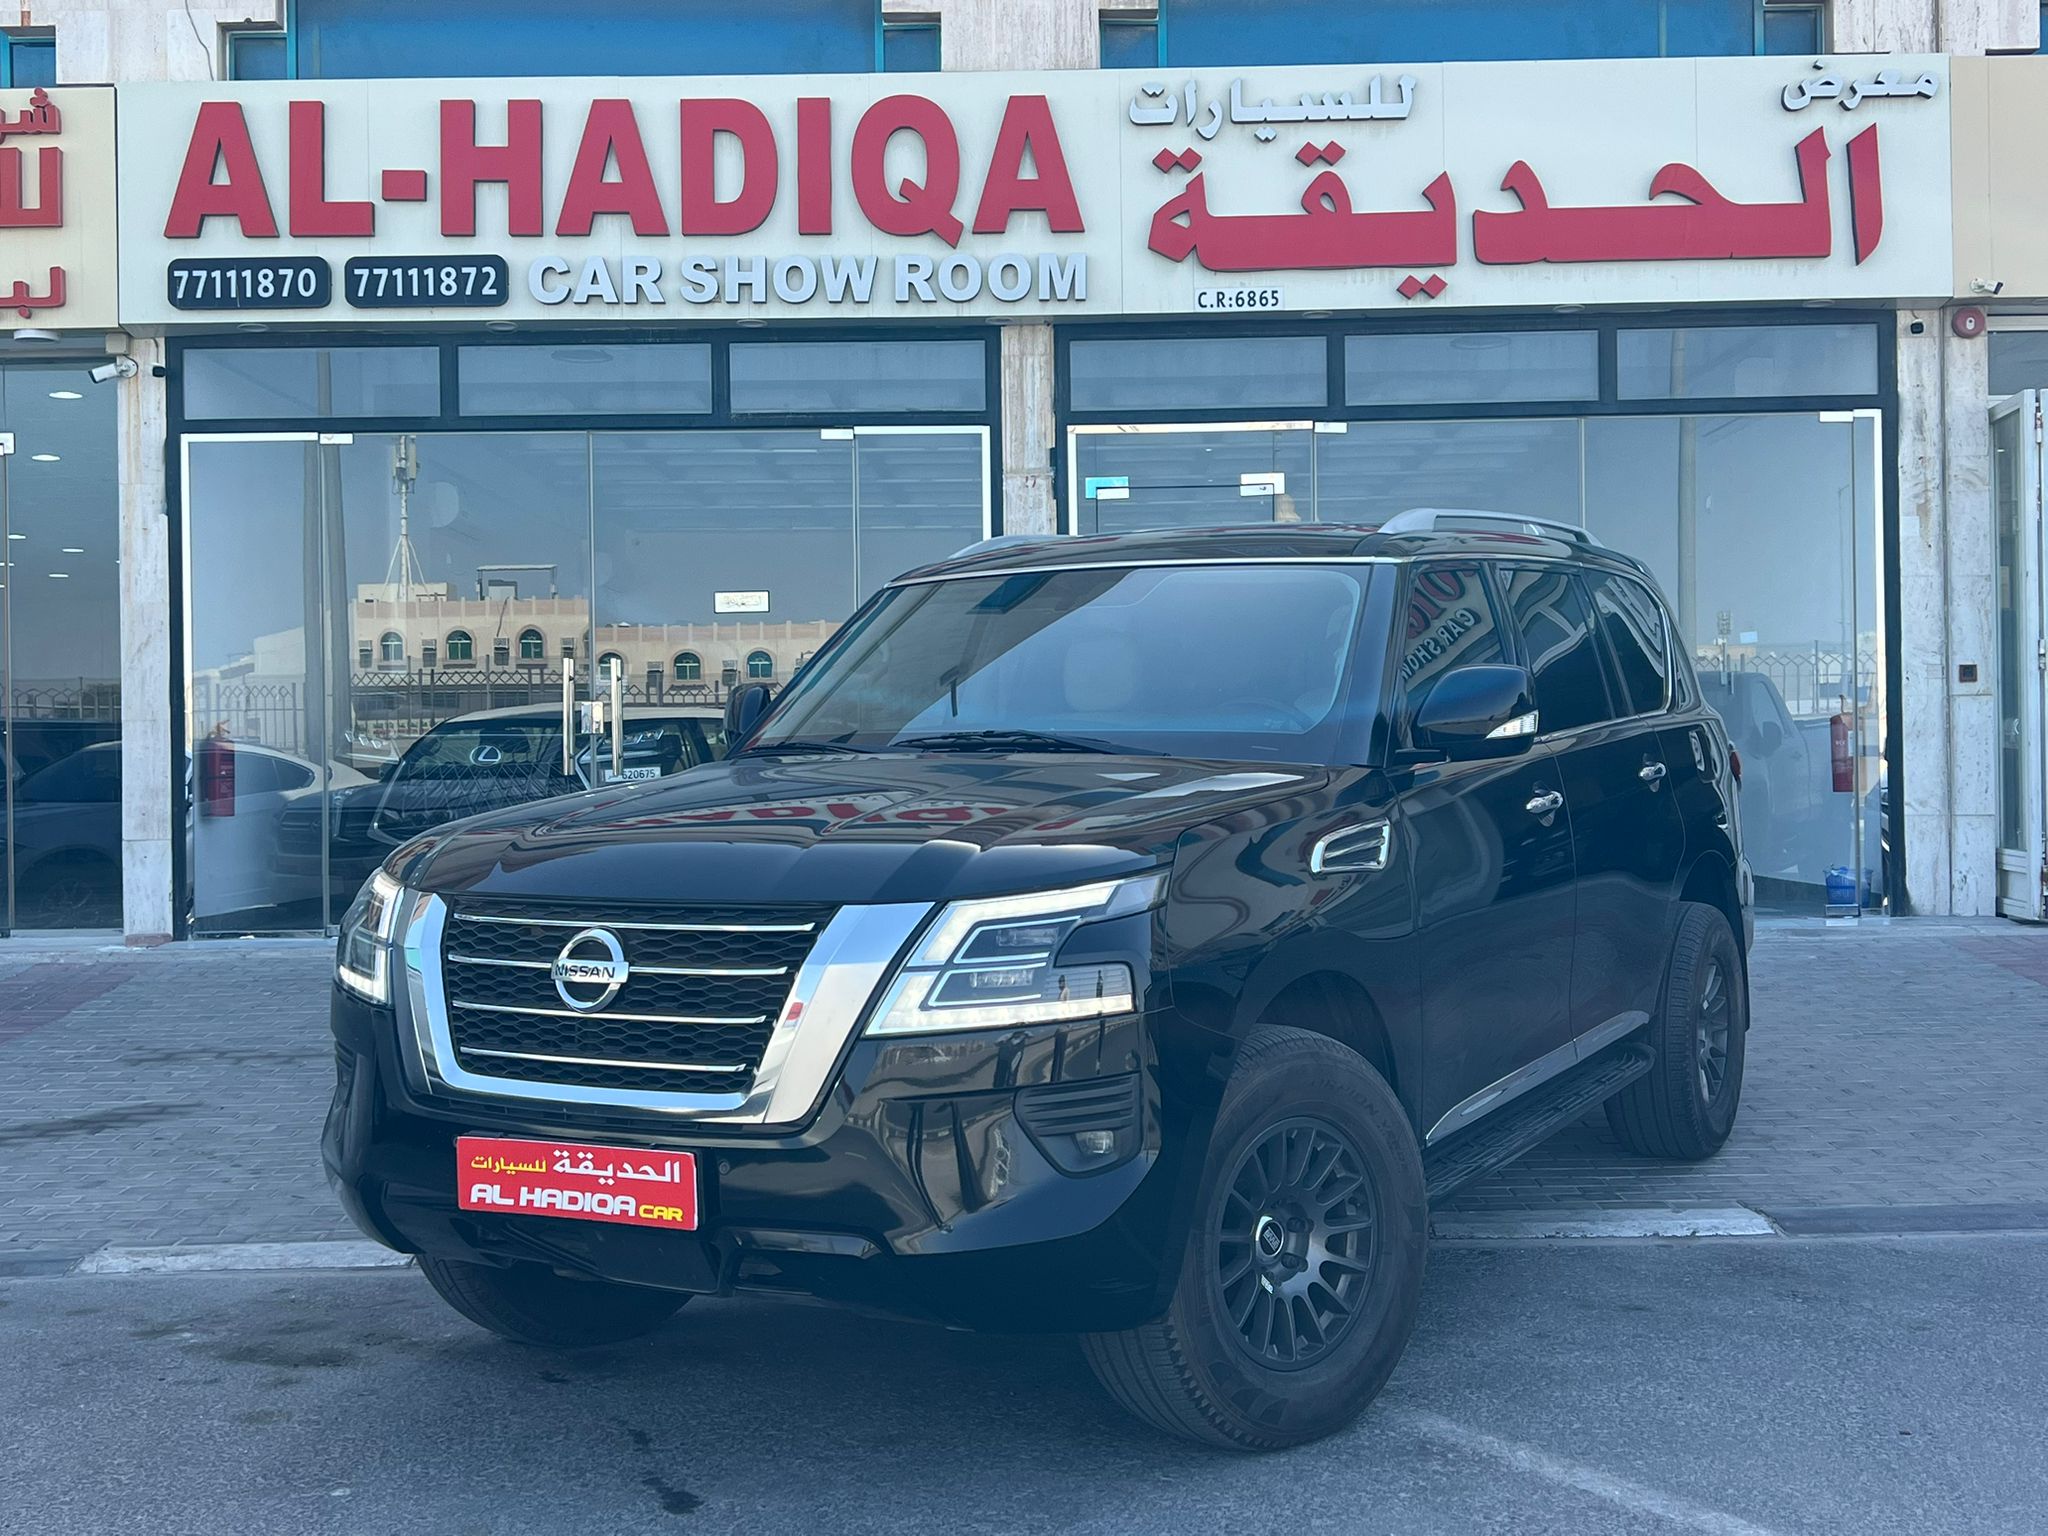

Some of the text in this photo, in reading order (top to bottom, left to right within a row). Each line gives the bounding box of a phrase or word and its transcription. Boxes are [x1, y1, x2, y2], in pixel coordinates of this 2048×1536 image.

[1781, 60, 1941, 111] معرض
[1128, 73, 1417, 143] للسيارات
[164, 94, 1086, 249] AL-HADIQA
[1147, 121, 1884, 300] الحديقة
[173, 269, 317, 299] 77111870
[353, 266, 498, 297] 77111872
[527, 252, 1088, 306] CAR SHOW ROOM
[1196, 290, 1281, 310] C.R:6865
[554, 963, 616, 979] NISSAN
[470, 1149, 681, 1186] الحديقة للسيارات
[470, 1183, 684, 1222] AL HADIQA CAR
